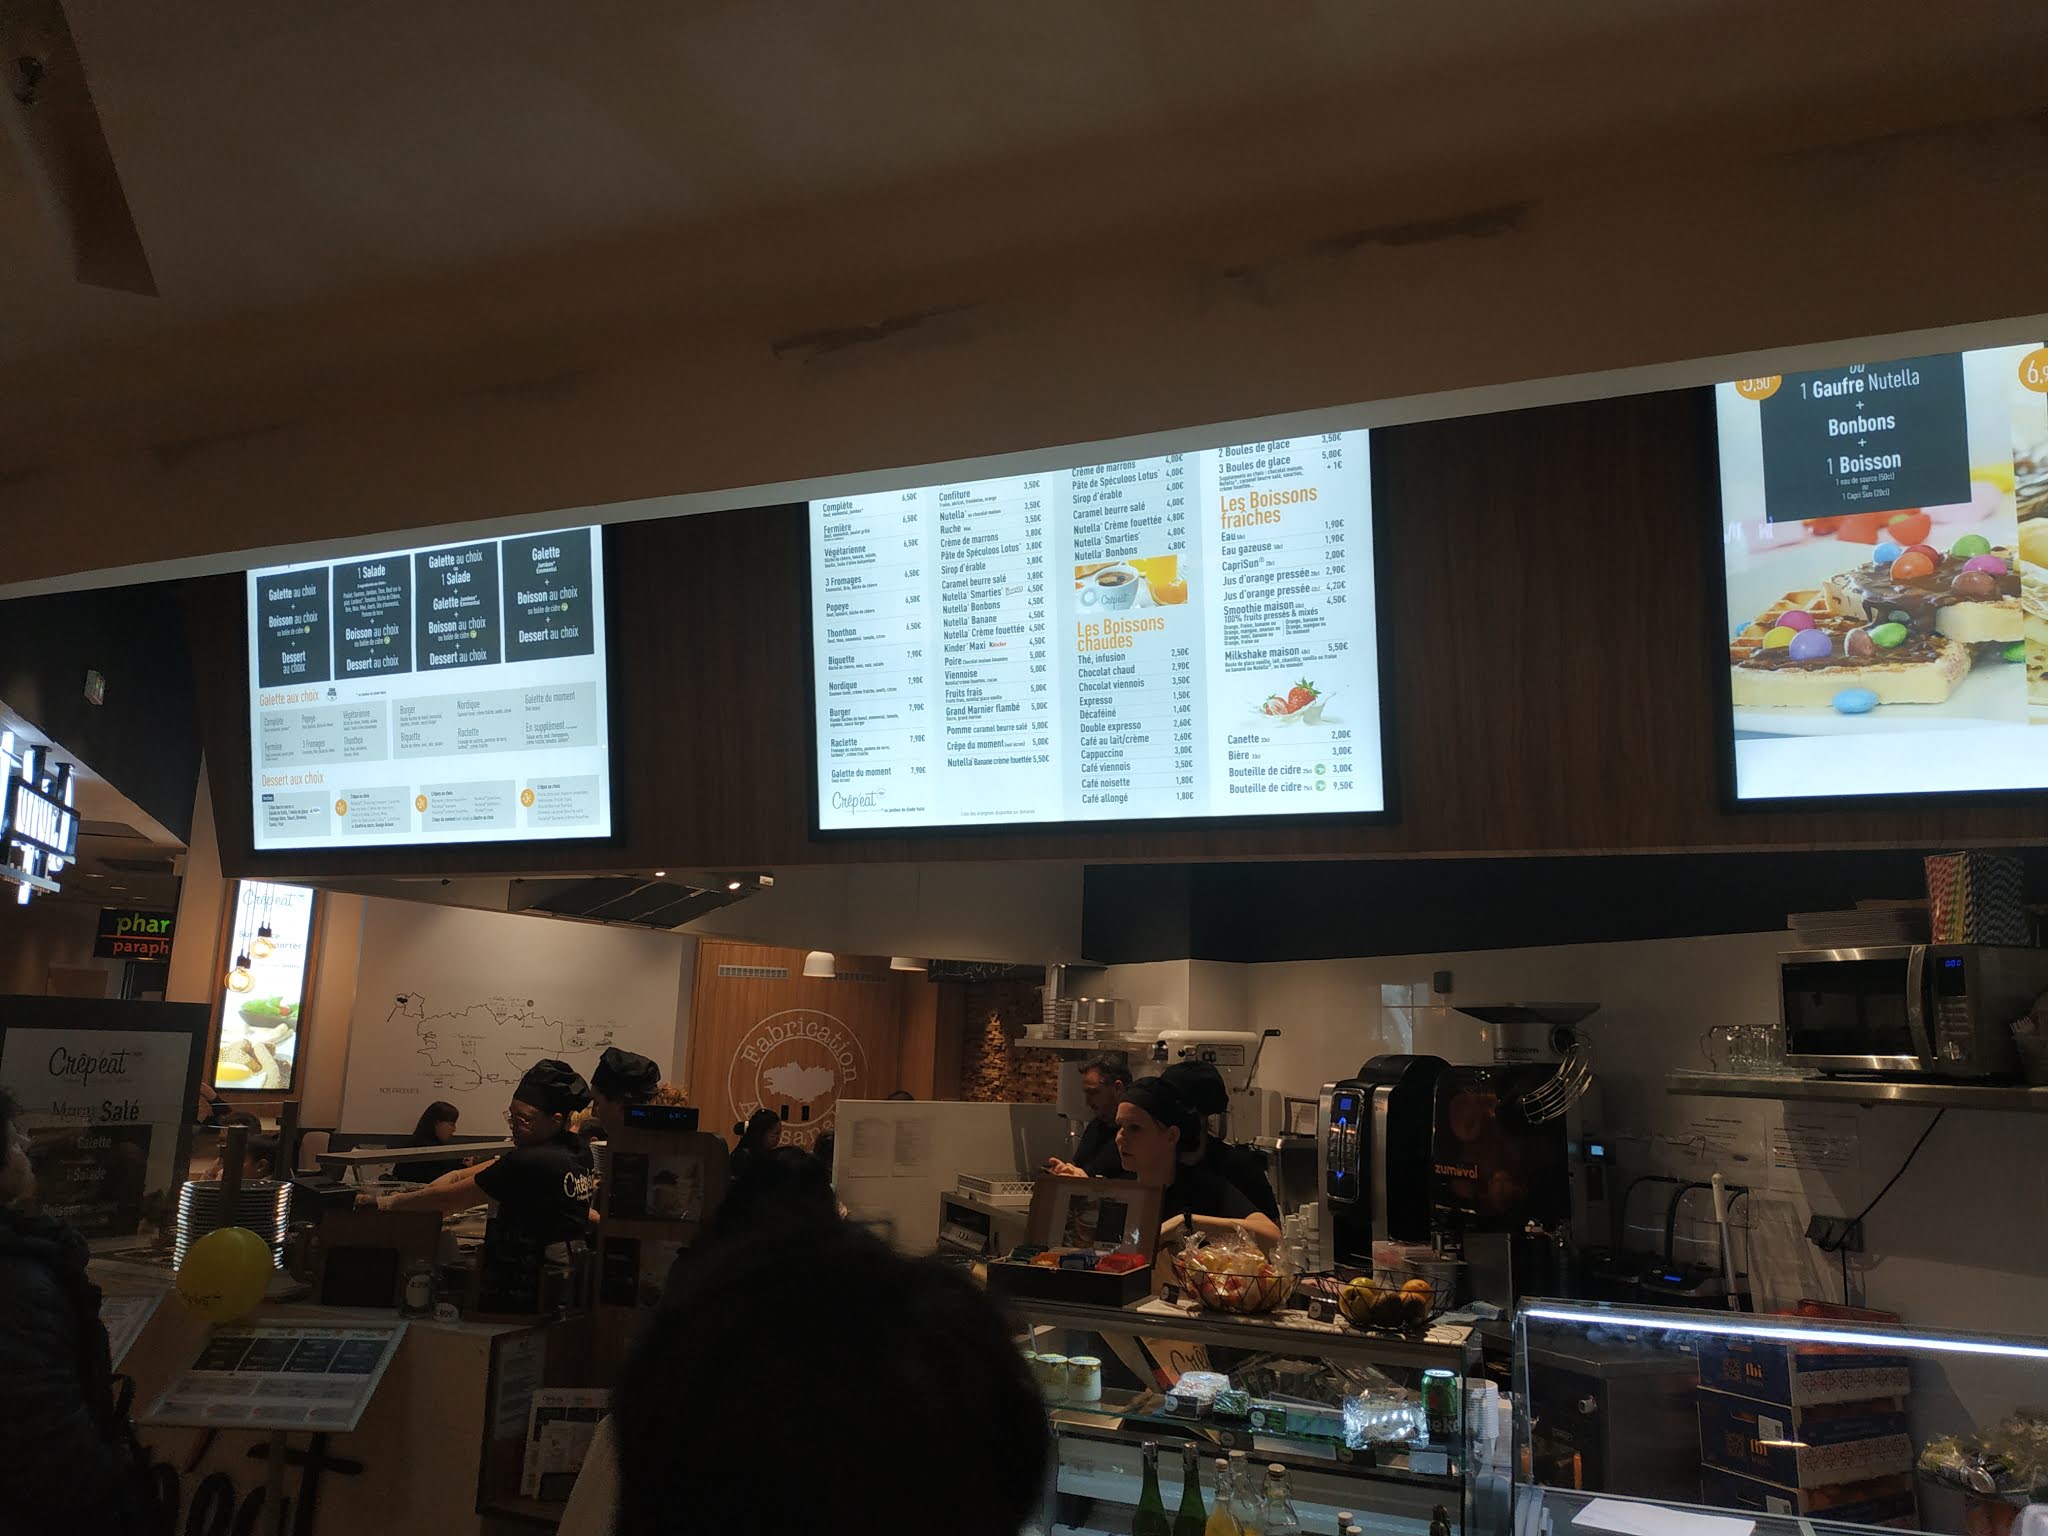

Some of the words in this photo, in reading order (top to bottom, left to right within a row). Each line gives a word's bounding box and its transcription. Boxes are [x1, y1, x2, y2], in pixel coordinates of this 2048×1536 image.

[1800, 383, 1807, 400] 1
[1812, 377, 1864, 399] Gaufre
[1868, 370, 1920, 392] Nutella
[1828, 414, 1896, 437] Bonbons
[1219, 464, 1223, 473] 3
[1226, 460, 1250, 473] Boules
[1252, 458, 1266, 470] de
[1268, 455, 1291, 468] glace
[1322, 449, 1342, 460] 5,00€
[1827, 458, 1833, 474] 1
[1839, 452, 1901, 474] Boisson
[1851, 475, 1860, 484] de
[1861, 474, 1877, 484] source
[939, 490, 970, 501] Confiture
[1024, 480, 1040, 489] 3,50€
[1847, 490, 1861, 500] Capri
[1862, 490, 1873, 498] Sun
[823, 501, 853, 512] Complète
[902, 493, 917, 501] 6,50€
[1220, 494, 1245, 512] Les
[1250, 486, 1317, 509] Boissons
[824, 523, 851, 534] Fermière
[903, 515, 918, 523] 6,50€
[940, 525, 961, 534] Ruche
[1025, 515, 1041, 523] 3,50€
[1221, 505, 1281, 529] fraîches
[1221, 531, 1235, 542] Eau
[1325, 519, 1344, 529] 1,90€
[825, 545, 866, 557] Végétarienne
[904, 539, 919, 547] 6,50€
[1222, 545, 1236, 556] Eau
[1239, 541, 1271, 555] gazeuse
[1325, 533, 1345, 544] 1,90€
[429, 556, 454, 568] Galette
[456, 556, 464, 565] au
[466, 551, 483, 563] choix
[532, 547, 560, 560] Galette
[358, 567, 361, 579] 1
[363, 565, 385, 578] Salade
[826, 578, 830, 587] 3
[831, 576, 862, 587] Fromages
[905, 569, 920, 578] 6,50€
[1223, 575, 1236, 587] Jus
[1277, 568, 1309, 581] pressée
[1326, 565, 1346, 575] 2,90€
[826, 603, 849, 612] Popeye
[905, 596, 920, 604] 6,50€
[1224, 603, 1261, 616] Smoothie
[1263, 600, 1294, 611] maison
[1327, 594, 1346, 605] 4,50€
[1224, 613, 1242, 623] 100%
[1243, 611, 1261, 621] fruits
[1263, 609, 1288, 621] pressés
[1291, 608, 1296, 616] &
[1298, 606, 1318, 616] mixés
[429, 622, 456, 634] Boisson
[458, 621, 466, 630] au
[469, 617, 486, 628] choix
[827, 628, 857, 638] Thonthon
[906, 622, 921, 631] 6,50€
[1077, 621, 1099, 637] Les
[1103, 617, 1164, 636] Boissons
[519, 629, 548, 643] Dessert
[550, 630, 558, 639] au
[561, 625, 579, 638] choix
[1078, 633, 1133, 652] chaudes
[1096, 652, 1125, 663] infusion
[1171, 648, 1189, 657] 2,50€
[1225, 649, 1268, 662] Milkshake
[1270, 647, 1299, 658] maison
[1328, 642, 1348, 653] 5,50€
[828, 655, 855, 666] Biquette
[945, 670, 977, 679] Viennoise
[1078, 666, 1110, 678] Chocolat
[1113, 664, 1135, 676] chaud
[829, 681, 857, 692] Nordique
[908, 676, 923, 685] 7,90€
[1079, 680, 1111, 692] Chocolat
[1113, 678, 1145, 689] viennois
[1172, 677, 1190, 686] 3,50€
[260, 693, 285, 706] Galette
[287, 693, 298, 702] aux
[301, 690, 319, 701] choix
[946, 689, 965, 699] Fruits
[967, 688, 982, 696] frais
[1080, 695, 1113, 707] Expresso
[1173, 691, 1191, 700] 1,50€
[830, 708, 851, 717] Burger
[909, 704, 924, 712] 7,90€
[946, 706, 965, 716] Grand
[968, 704, 994, 715] Marnier
[996, 702, 1020, 712] flambé
[1080, 707, 1116, 719] Décaféiné
[1173, 705, 1191, 714] 1,60€
[458, 728, 479, 737] Raclette
[1080, 722, 1105, 733] Double
[1108, 720, 1141, 732] expresso
[1174, 718, 1191, 728] 2,60€
[401, 732, 421, 741] Biquette
[831, 738, 857, 747] Raclette
[910, 735, 925, 743] 7,90€
[1081, 736, 1097, 746] Café
[1099, 737, 1109, 745] au
[1111, 733, 1149, 745] lait/crème
[1174, 732, 1192, 742] 2,60€
[1228, 734, 1259, 745] Canette
[1331, 730, 1351, 741] 2,00€
[1081, 748, 1124, 761] Cappuccino
[1228, 749, 1249, 761] Bière
[1332, 747, 1352, 757] 3,00€
[832, 768, 855, 778] Galette
[857, 769, 865, 777] du
[866, 767, 891, 776] moment
[911, 767, 926, 775] 7,90€
[1082, 762, 1098, 773] Café
[1100, 761, 1131, 772] viennois
[1175, 760, 1193, 769] 3,50€
[1229, 767, 1265, 778] Bouteille
[1268, 767, 1278, 776] de
[1280, 765, 1301, 776] cidre
[1333, 763, 1353, 774] 3,00€
[262, 774, 288, 786] Dessert
[291, 775, 302, 784] aux
[305, 771, 324, 783] choix
[1082, 778, 1098, 789] Café
[1100, 776, 1130, 787] noisette
[1176, 776, 1193, 785] 1,80€
[1082, 793, 1099, 804] Café
[1101, 791, 1128, 804] allongé
[1176, 792, 1194, 801] 1,80€
[117, 913, 172, 934] phar
[113, 940, 169, 955] paraph
[741, 1017, 857, 1084] Fabrication
[100, 1100, 140, 1121] Salé
